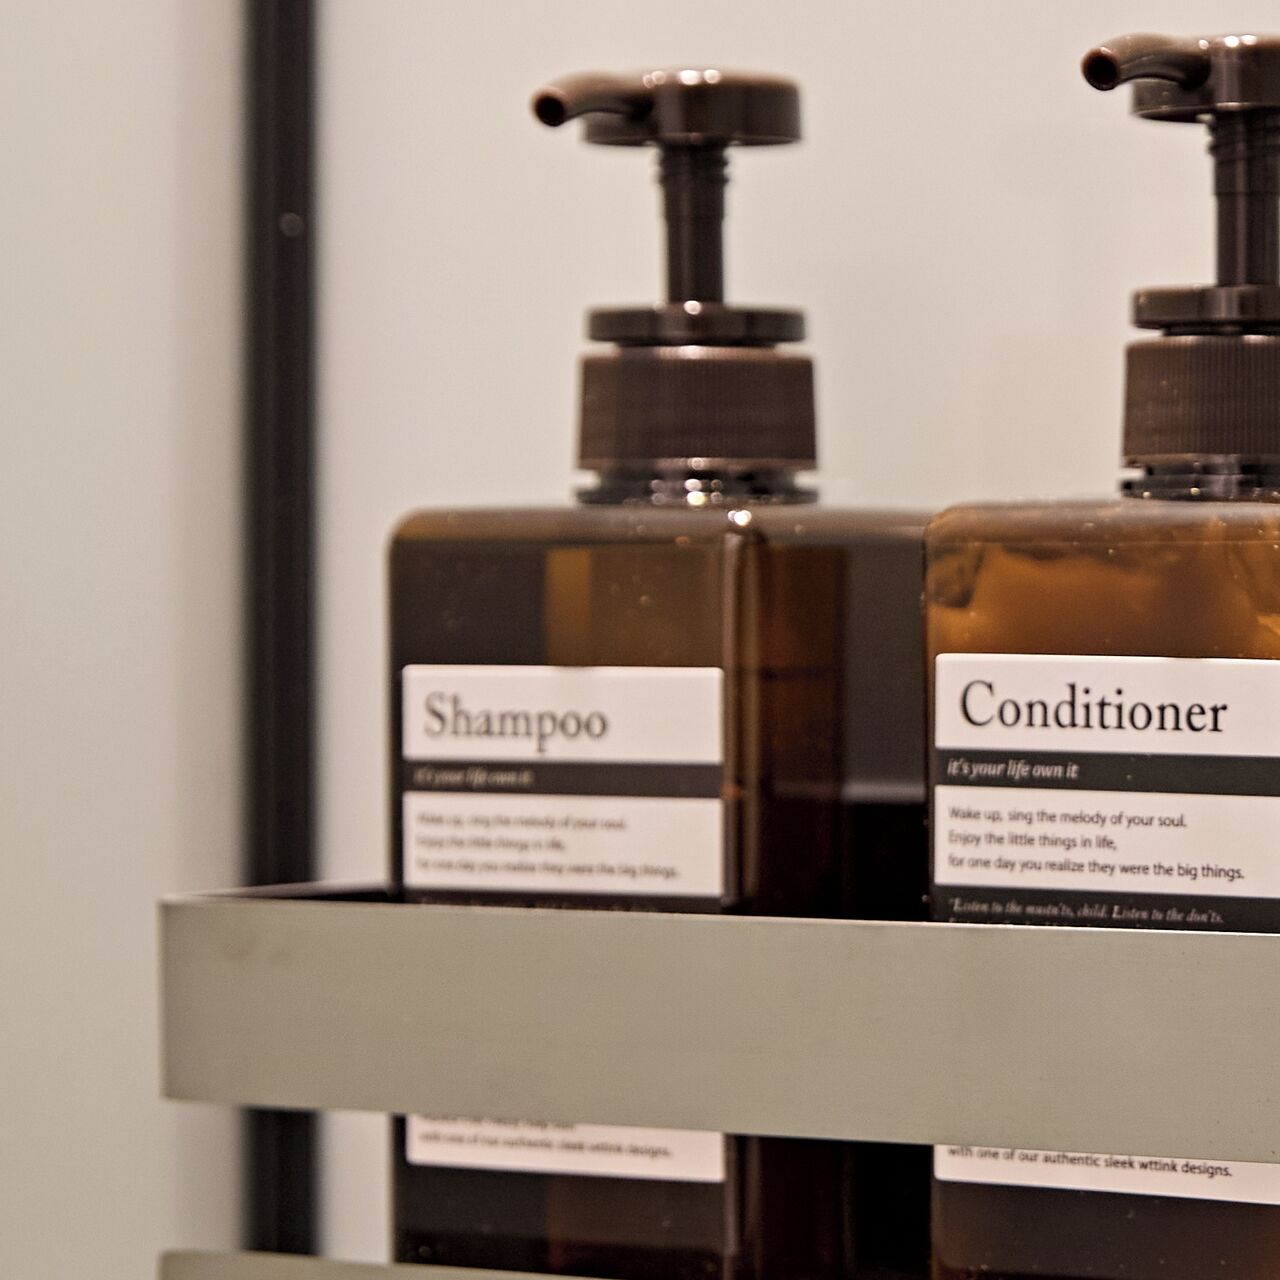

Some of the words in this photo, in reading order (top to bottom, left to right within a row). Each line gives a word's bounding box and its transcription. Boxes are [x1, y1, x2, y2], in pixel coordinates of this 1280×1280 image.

[959, 679, 1228, 733] Conditioner
[424, 691, 611, 755] Shampoo
[946, 757, 969, 777] it's
[970, 761, 1006, 779] your
[1006, 759, 1031, 781] life
[1031, 764, 1065, 779] own
[1065, 762, 1080, 780] it
[949, 806, 982, 821] Wake
[983, 810, 1004, 824] up,
[1007, 810, 1034, 826] sing
[1035, 809, 1058, 824] the
[1059, 810, 1108, 829] melody
[1109, 810, 1124, 826] of
[1124, 815, 1155, 830] your
[1157, 813, 1188, 828] soul.
[948, 829, 982, 848] Enjoy
[983, 831, 1006, 846] the
[1007, 832, 1036, 848] little
[1037, 833, 1078, 852] things
[1080, 837, 1093, 849] in
[1095, 834, 1118, 852] life,
[948, 854, 965, 868] for
[967, 858, 992, 869] one
[993, 856, 1017, 873] day
[1018, 859, 1043, 873] you
[1044, 858, 1086, 873] realize
[1087, 859, 1117, 877] they
[1118, 864, 1151, 876] were
[1152, 861, 1175, 877] the
[1176, 862, 1199, 881] big
[1200, 863, 1245, 883] things.
[976, 1148, 1001, 1160] one
[1002, 1149, 1017, 1161] of
[1017, 1151, 1040, 1163] our
[1041, 1152, 1101, 1168] authentic
[1103, 1154, 1136, 1170] sleek
[1137, 1159, 1179, 1173] wttink
[1180, 1160, 1233, 1180] designs.
